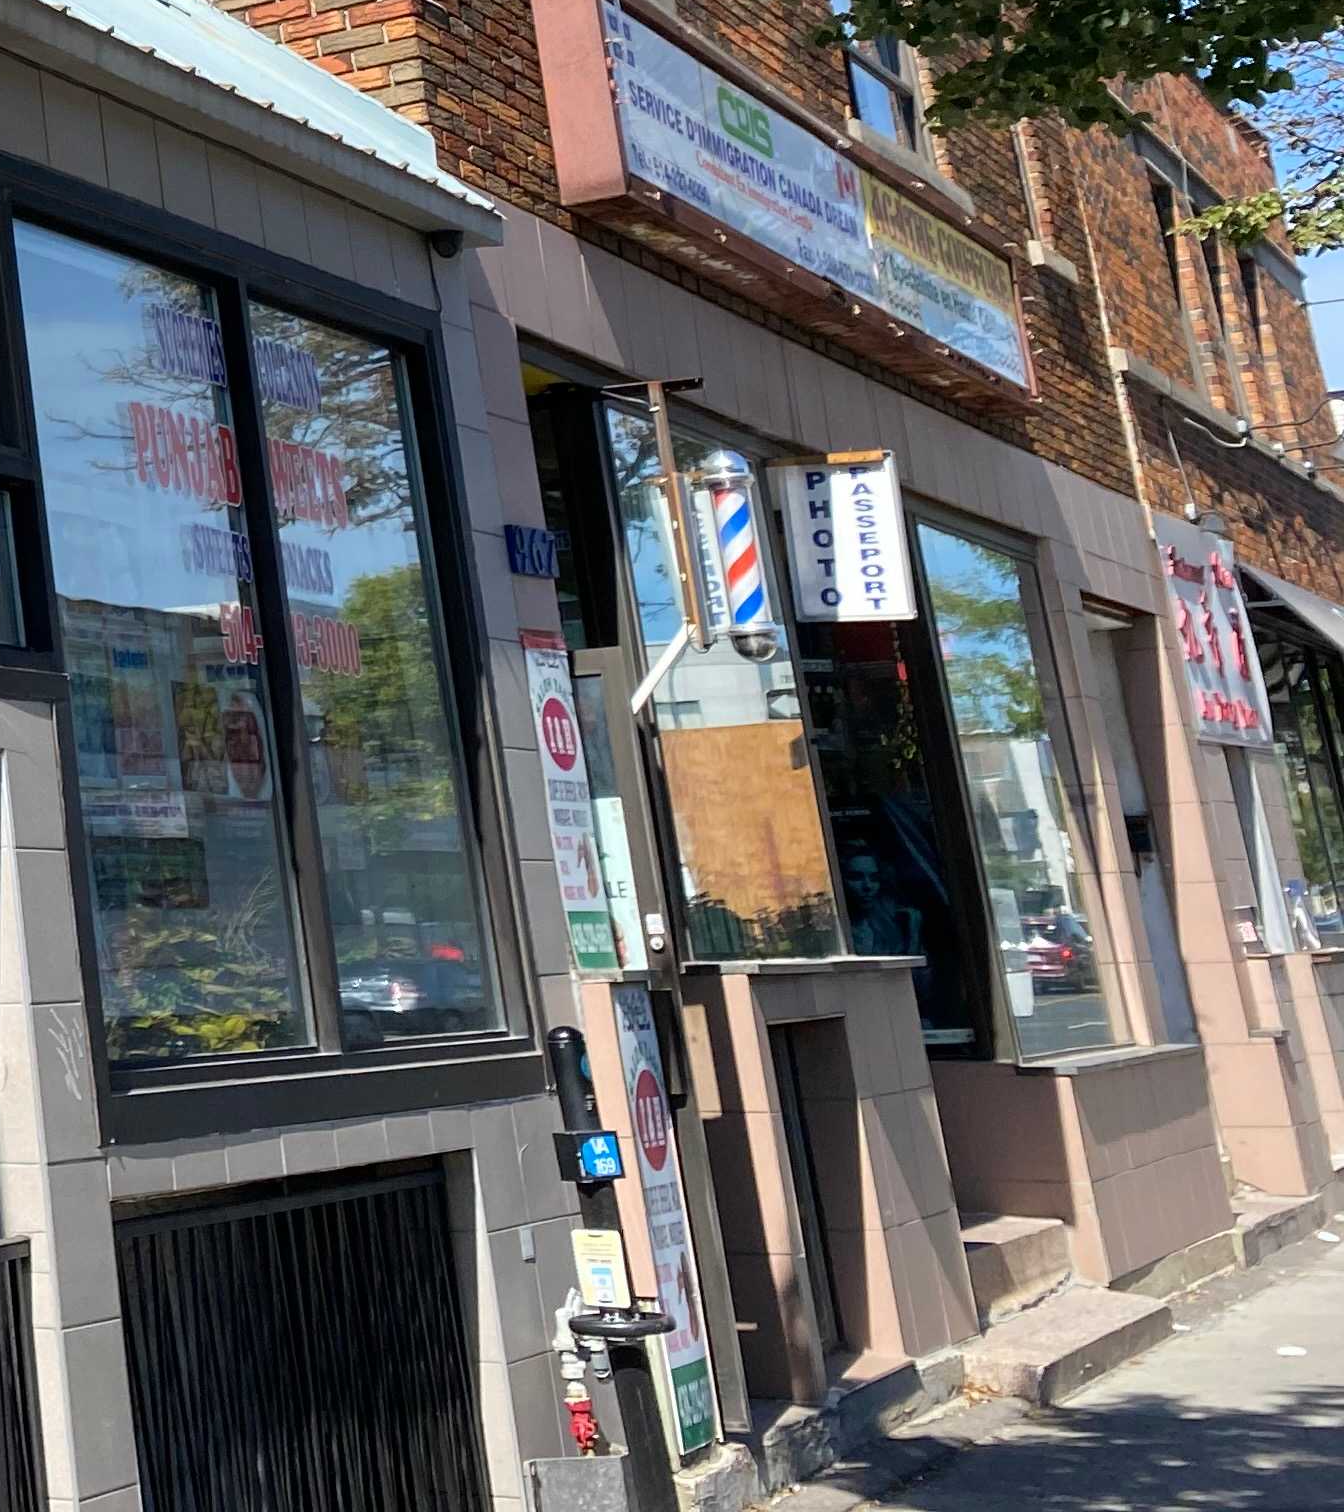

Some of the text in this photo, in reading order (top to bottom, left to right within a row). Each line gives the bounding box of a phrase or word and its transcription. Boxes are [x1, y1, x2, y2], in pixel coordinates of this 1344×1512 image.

[628, 80, 684, 135] SERVICE
[685, 116, 777, 191] D'IMMIGRATION
[779, 174, 823, 218] CANADA
[129, 402, 349, 529] PUNJAB WEETS
[280, 542, 334, 596] NACKS
[806, 472, 841, 606] PHOTO
[849, 467, 886, 609] PASSEPORT
[593, 1157, 616, 1175] 169
